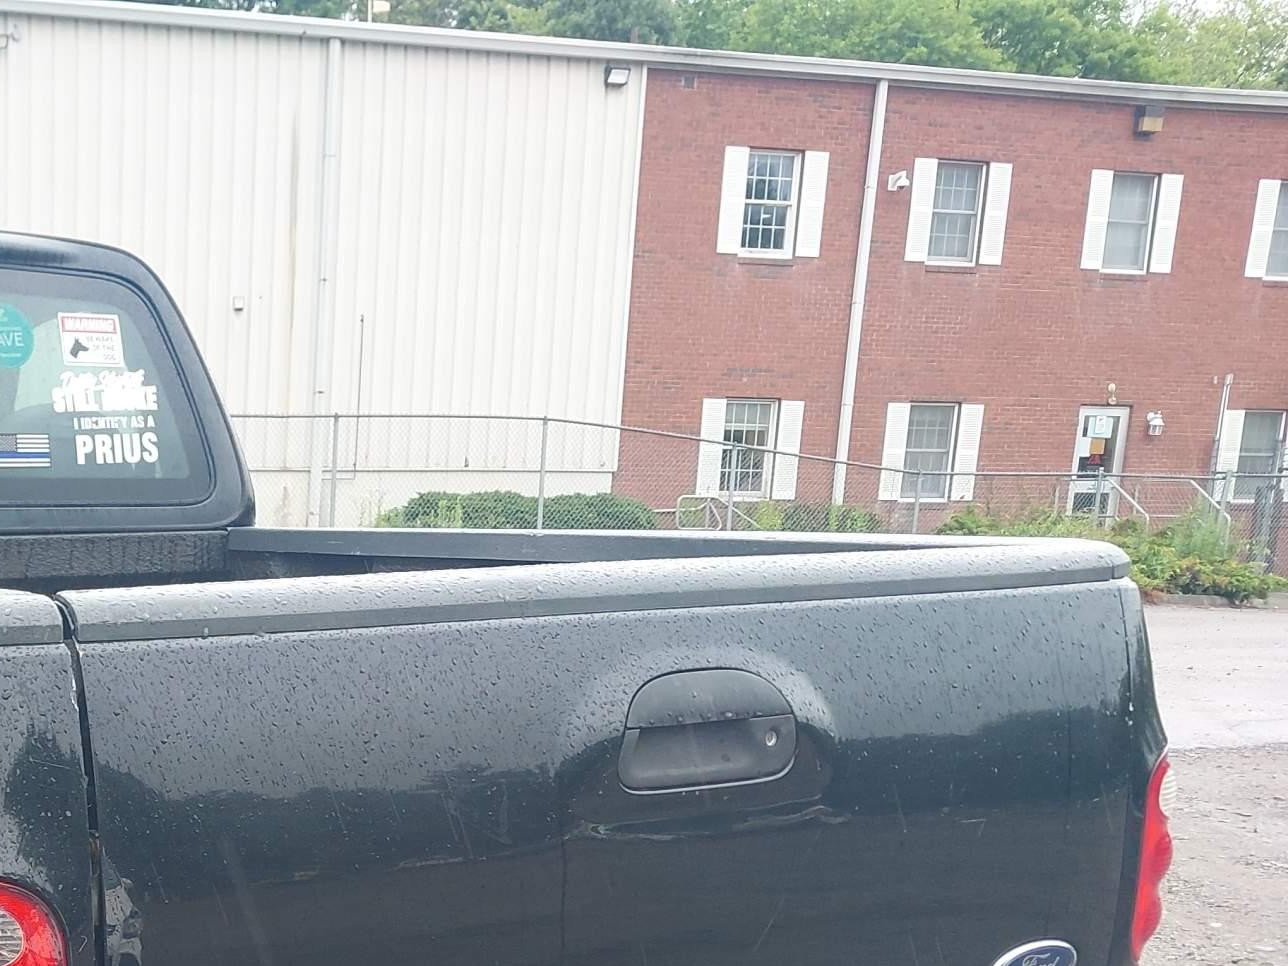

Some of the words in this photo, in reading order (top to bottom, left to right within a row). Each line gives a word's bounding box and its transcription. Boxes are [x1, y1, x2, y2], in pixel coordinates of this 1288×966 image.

[51, 386, 101, 413] STILL
[72, 416, 79, 430] I
[79, 416, 127, 430] IDENTIFY
[130, 415, 145, 429] AS
[146, 415, 156, 428] A
[74, 431, 159, 465] PRIUS
